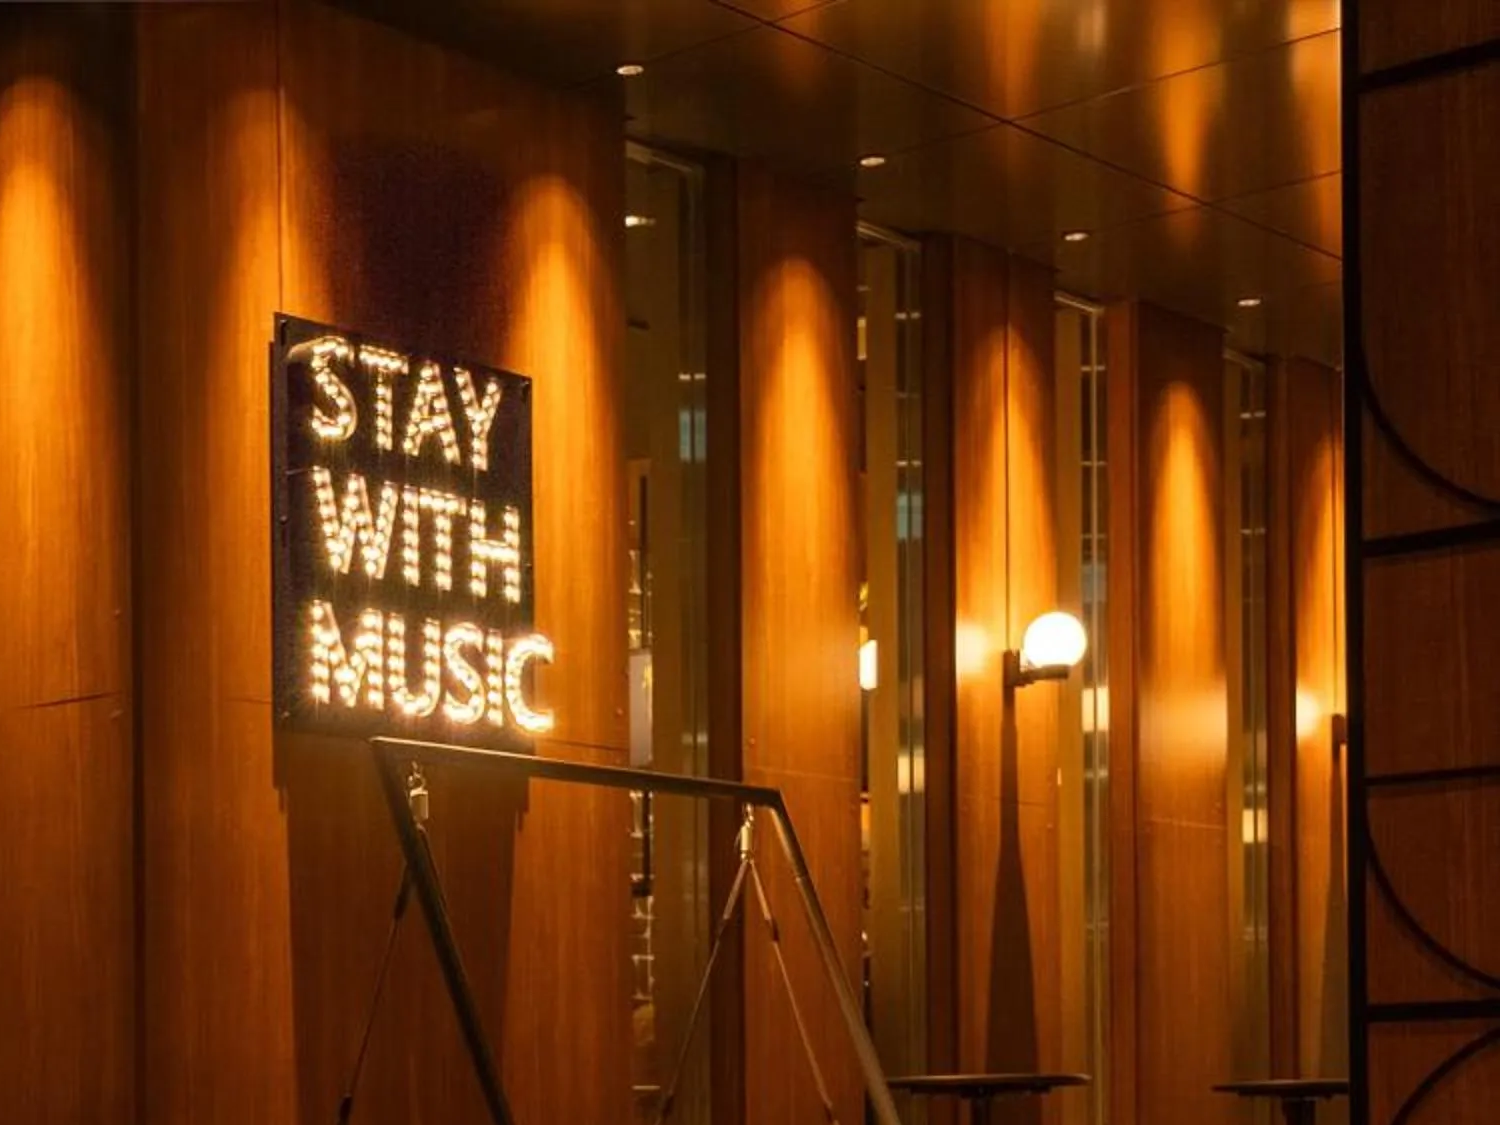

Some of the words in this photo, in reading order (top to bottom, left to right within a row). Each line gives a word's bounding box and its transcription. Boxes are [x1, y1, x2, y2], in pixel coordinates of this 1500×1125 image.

[306, 335, 501, 471] STAY
[312, 465, 521, 603] WITH
[309, 600, 556, 732] MUSIC
